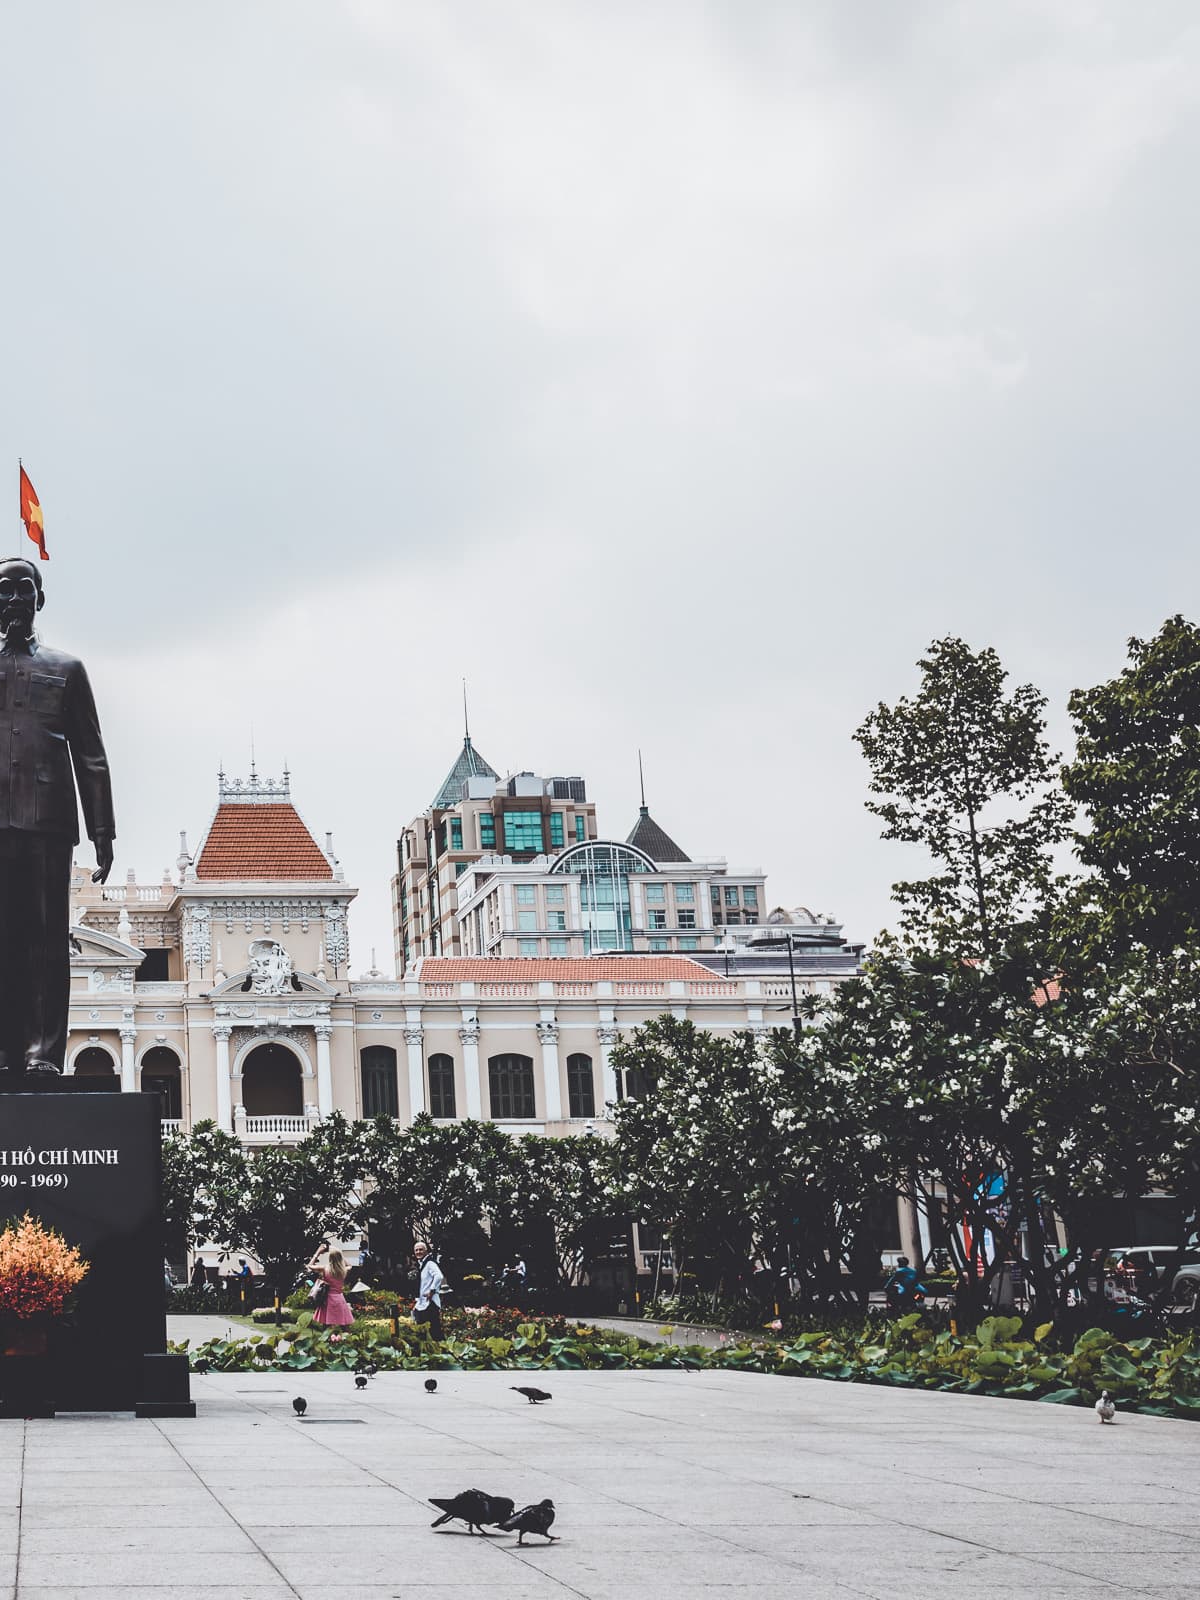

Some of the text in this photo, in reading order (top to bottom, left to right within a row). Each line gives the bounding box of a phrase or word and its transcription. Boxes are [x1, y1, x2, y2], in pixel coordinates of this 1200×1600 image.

[38, 1147, 69, 1166] CHÍ
[71, 1149, 119, 1165] MINH
[30, 1173, 69, 1189] 1969)
